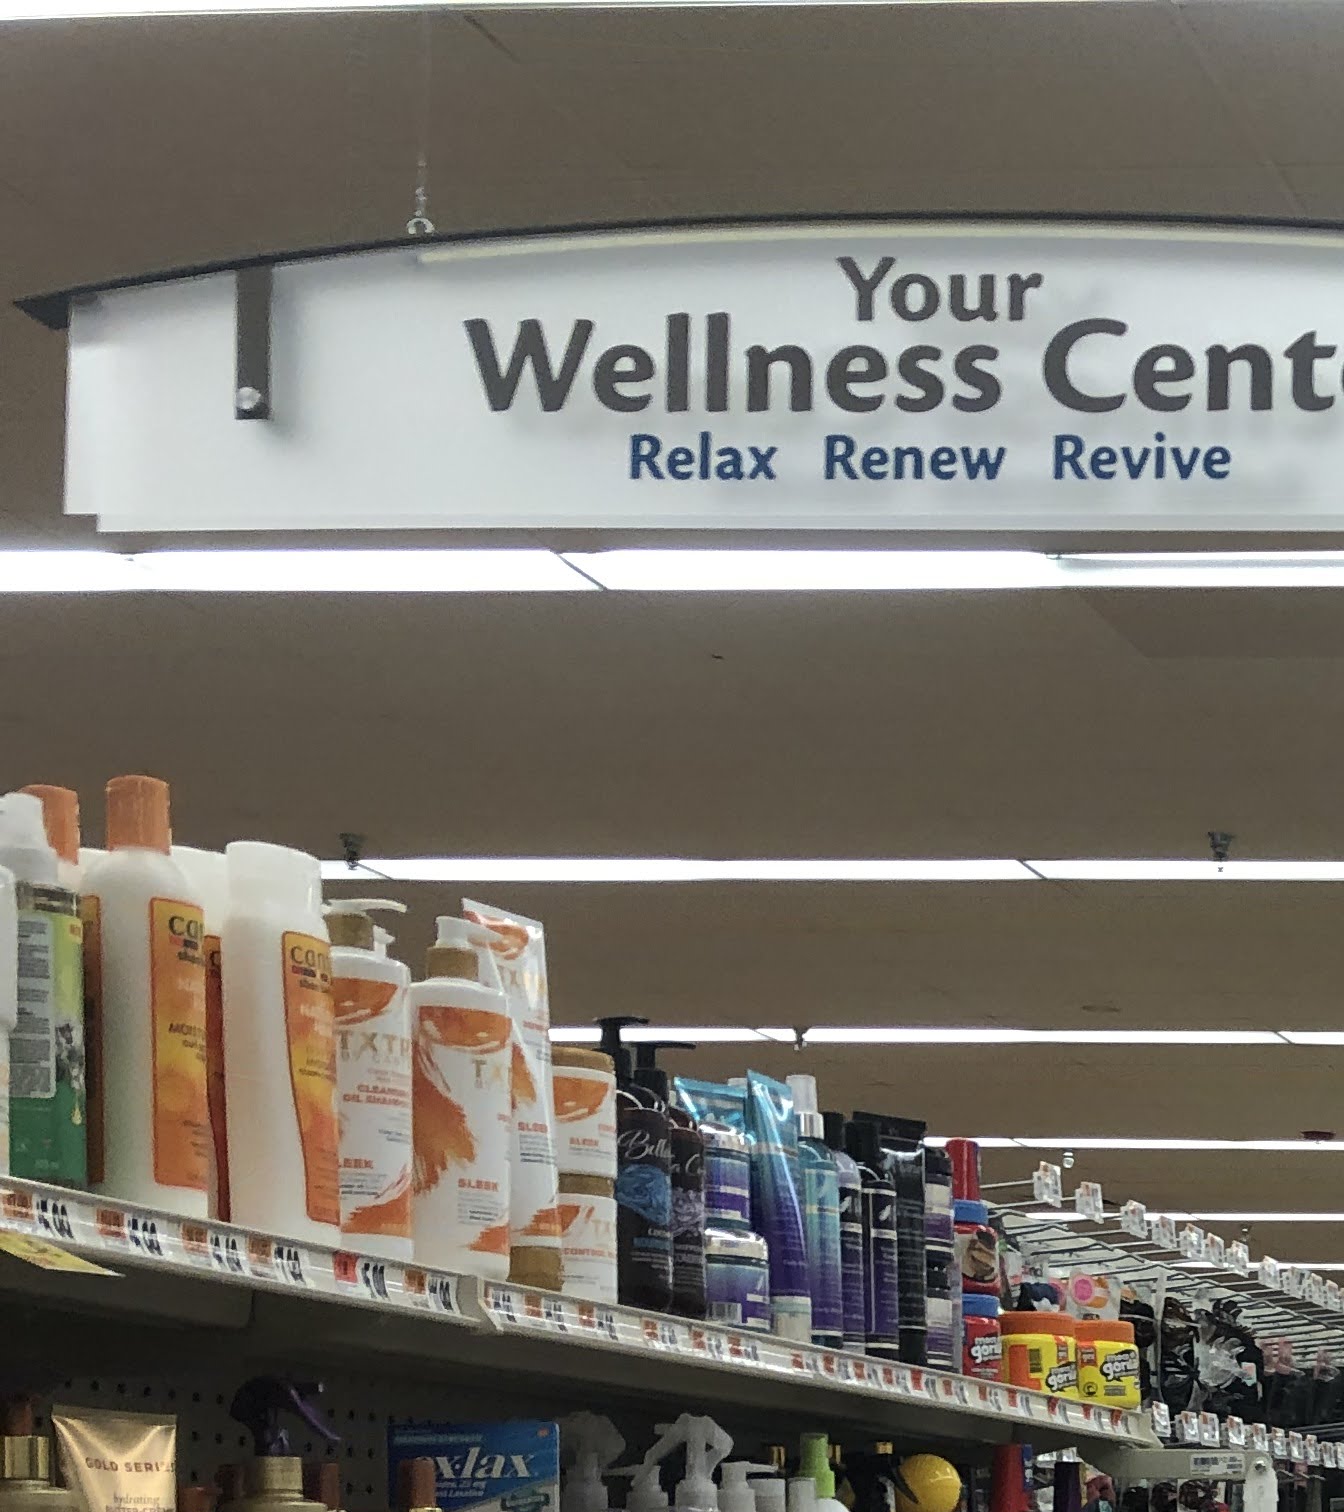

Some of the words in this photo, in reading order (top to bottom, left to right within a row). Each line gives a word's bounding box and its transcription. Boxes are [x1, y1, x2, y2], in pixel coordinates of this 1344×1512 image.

[837, 256, 1043, 323] Your
[465, 311, 1001, 414] Wellness
[629, 431, 778, 481] Relax
[823, 433, 1007, 481] Renew
[1052, 432, 1232, 482] Revive
[85, 1457, 118, 1472] GOLD
[124, 1461, 176, 1473] SERI
